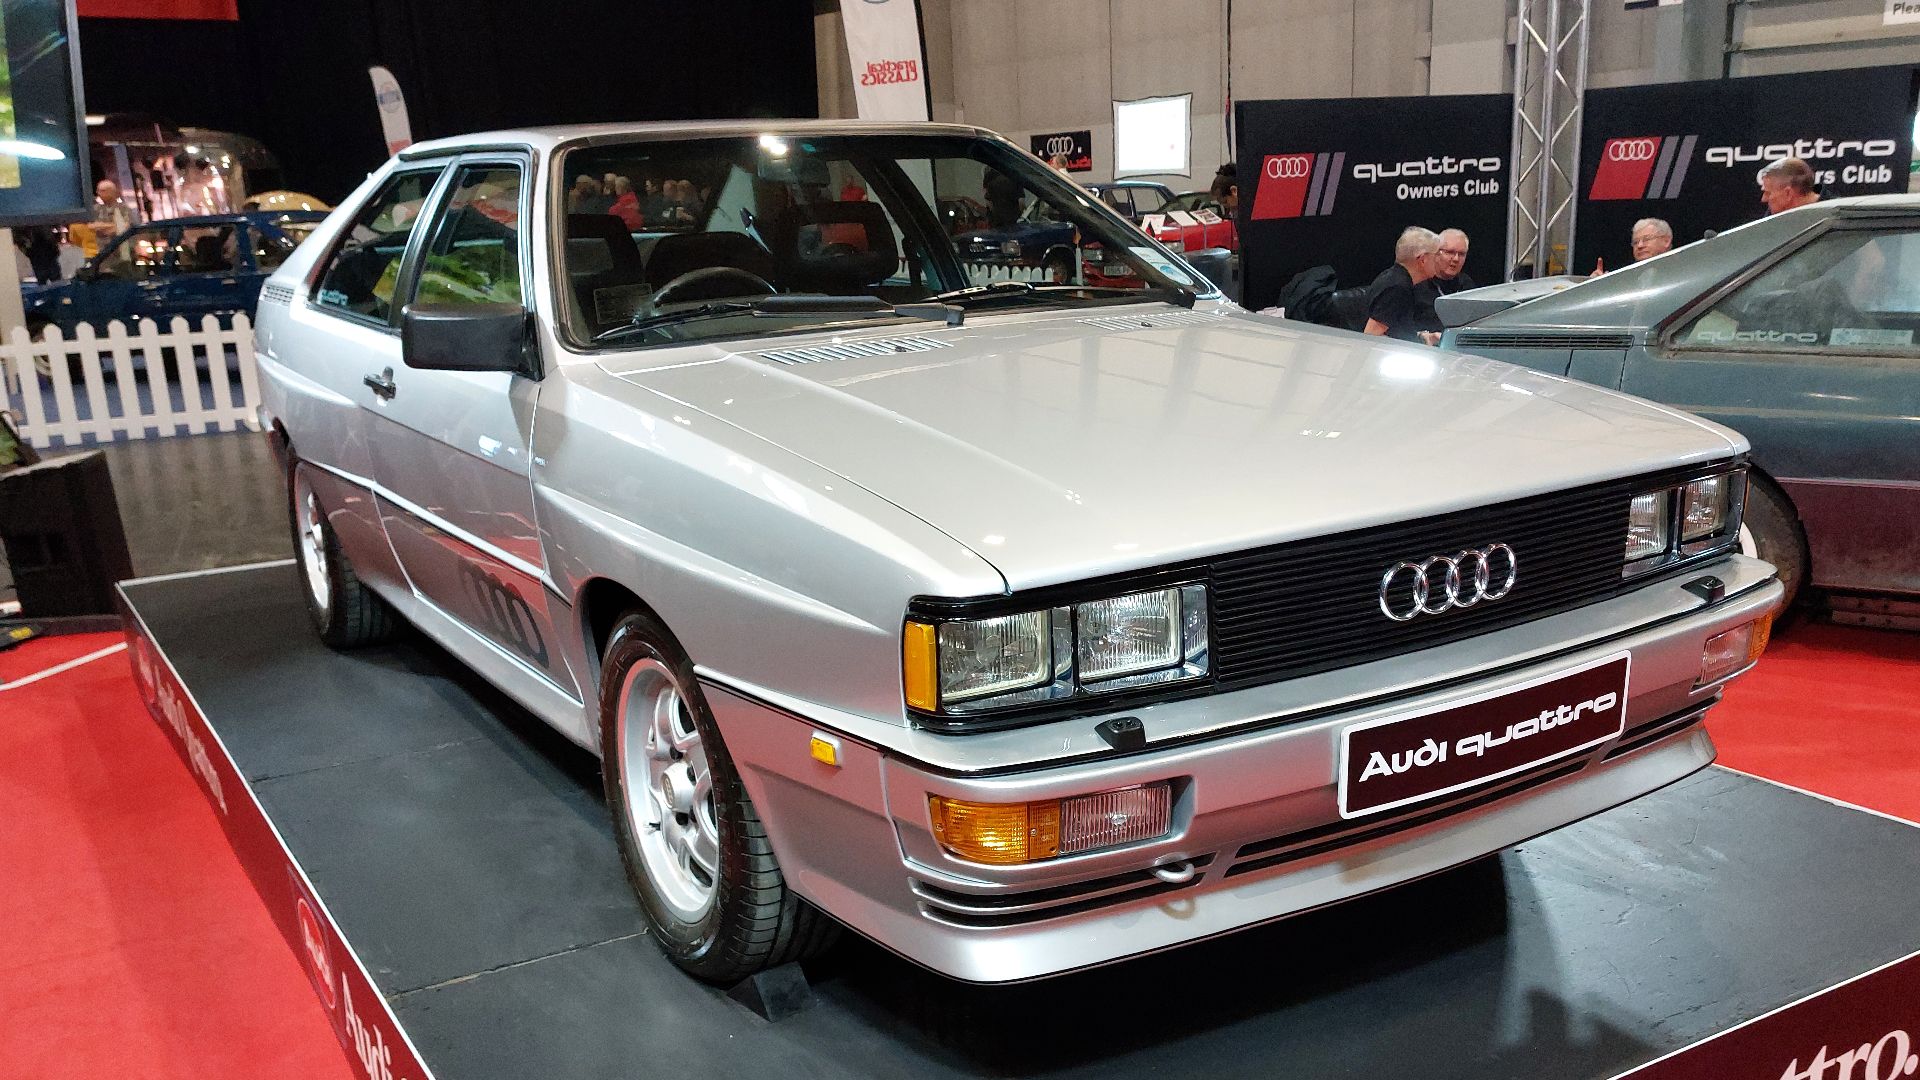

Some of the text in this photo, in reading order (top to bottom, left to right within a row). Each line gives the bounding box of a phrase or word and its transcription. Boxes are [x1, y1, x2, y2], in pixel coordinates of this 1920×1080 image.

[1705, 137, 1896, 168] quattro
[1353, 155, 1501, 184] quattro
[1842, 164, 1893, 185] Club
[1396, 178, 1500, 200] Owners Club
[1697, 329, 1818, 344] quattro
[1358, 691, 1617, 783] Audi quattro
